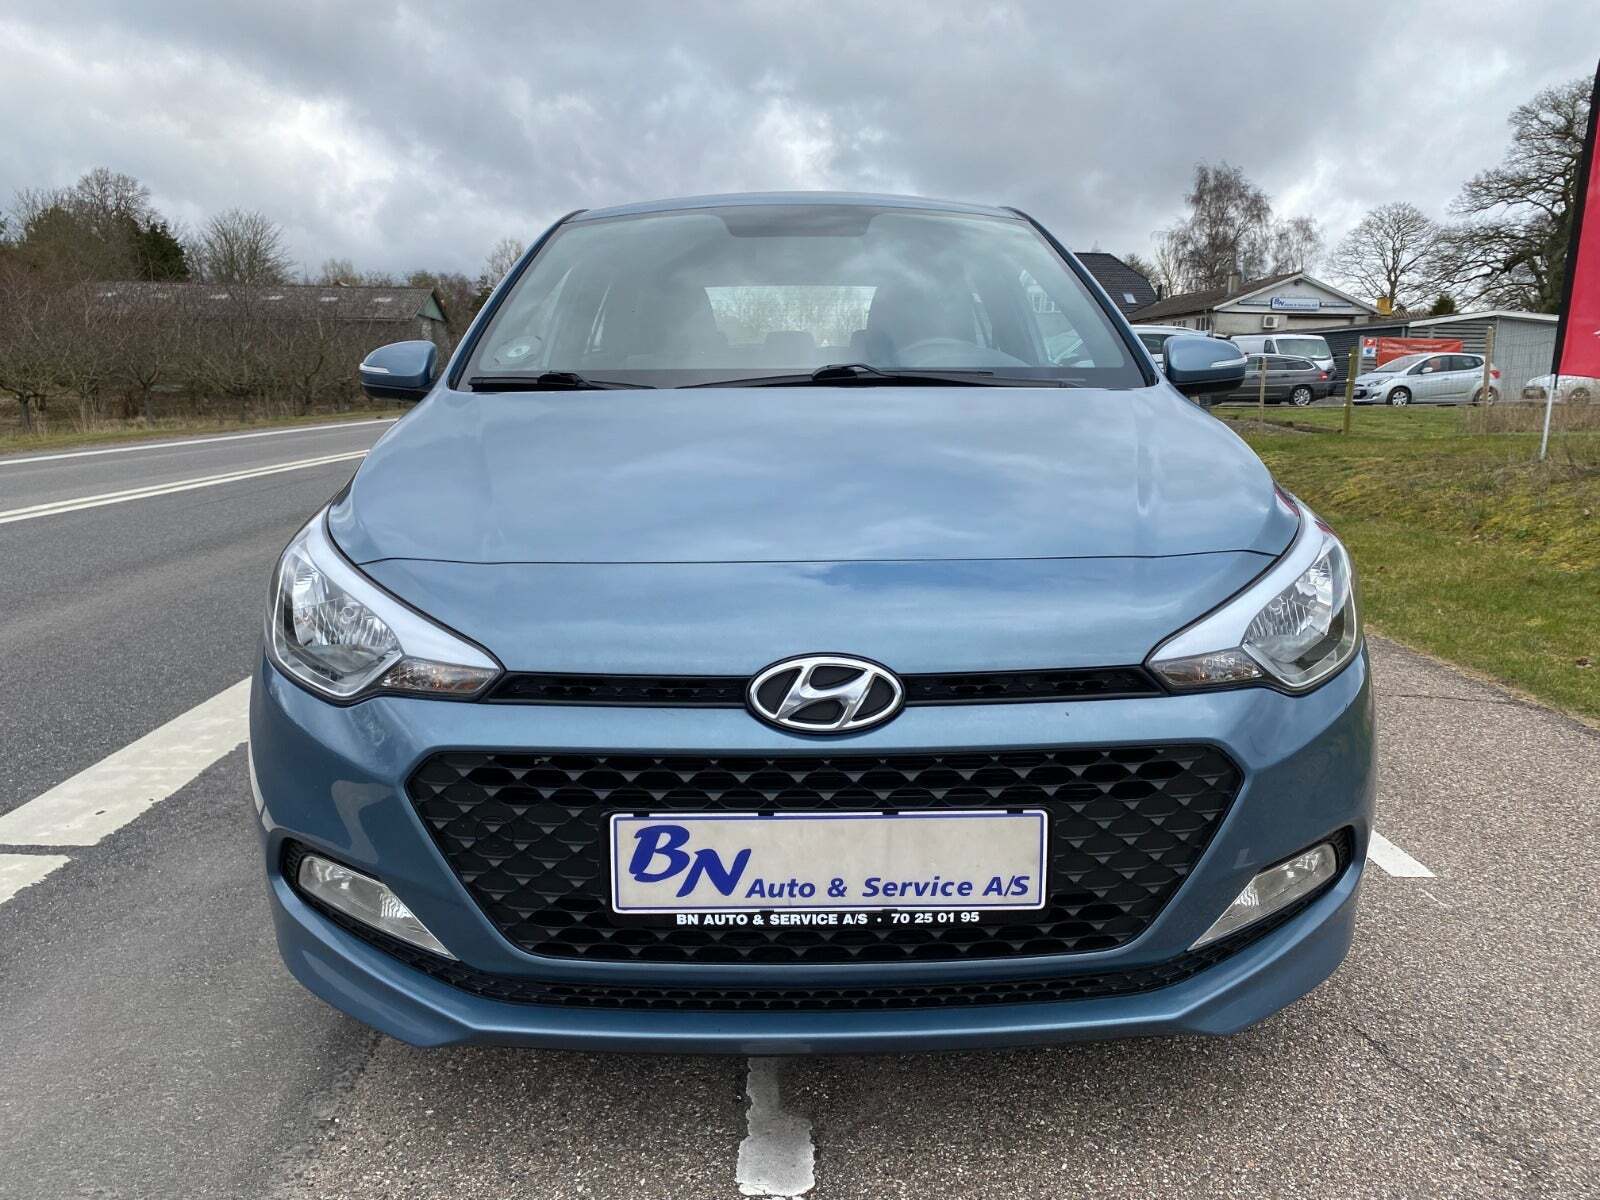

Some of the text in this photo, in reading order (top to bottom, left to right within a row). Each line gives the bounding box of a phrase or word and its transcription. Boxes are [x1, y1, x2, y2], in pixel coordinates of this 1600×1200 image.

[629, 825, 1030, 898] BN Auto & Service A/S
[676, 911, 980, 925] BN AUTO & SERVICE A/S 70 25 01 95
